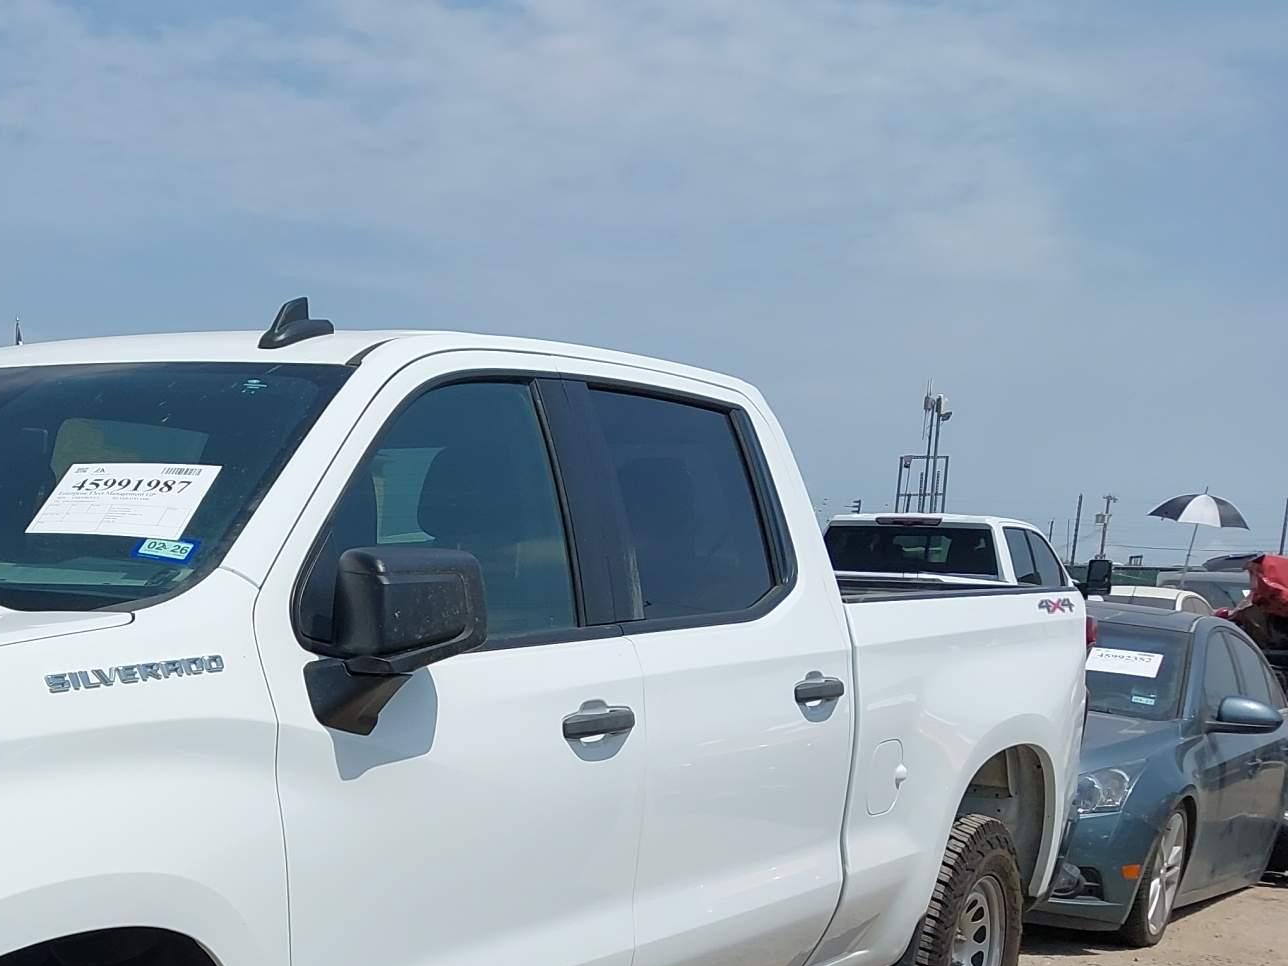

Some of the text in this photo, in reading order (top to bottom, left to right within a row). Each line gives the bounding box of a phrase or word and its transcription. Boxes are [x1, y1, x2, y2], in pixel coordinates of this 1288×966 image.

[72, 478, 192, 494] 45991987
[170, 545, 189, 555] 26
[44, 655, 225, 693] SILVERADO
